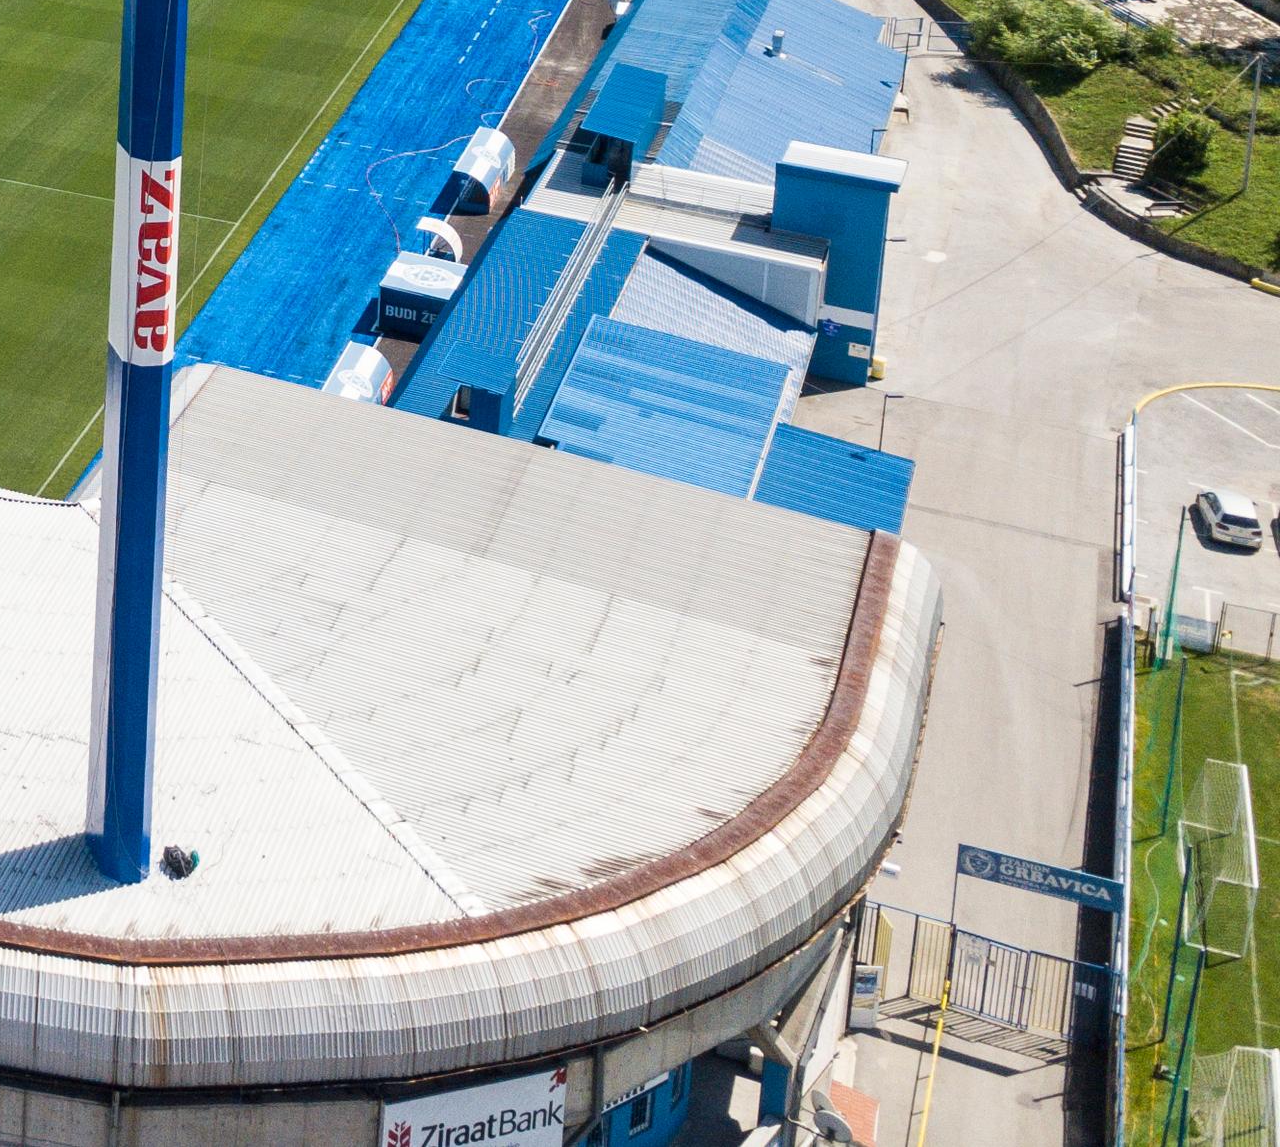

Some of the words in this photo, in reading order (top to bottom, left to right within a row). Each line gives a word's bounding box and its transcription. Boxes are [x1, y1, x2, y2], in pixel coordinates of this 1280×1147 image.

[133, 169, 176, 352] avaz
[385, 304, 417, 321] BUDI
[999, 855, 1051, 874] STADION
[999, 863, 1112, 901] GRBAVICA
